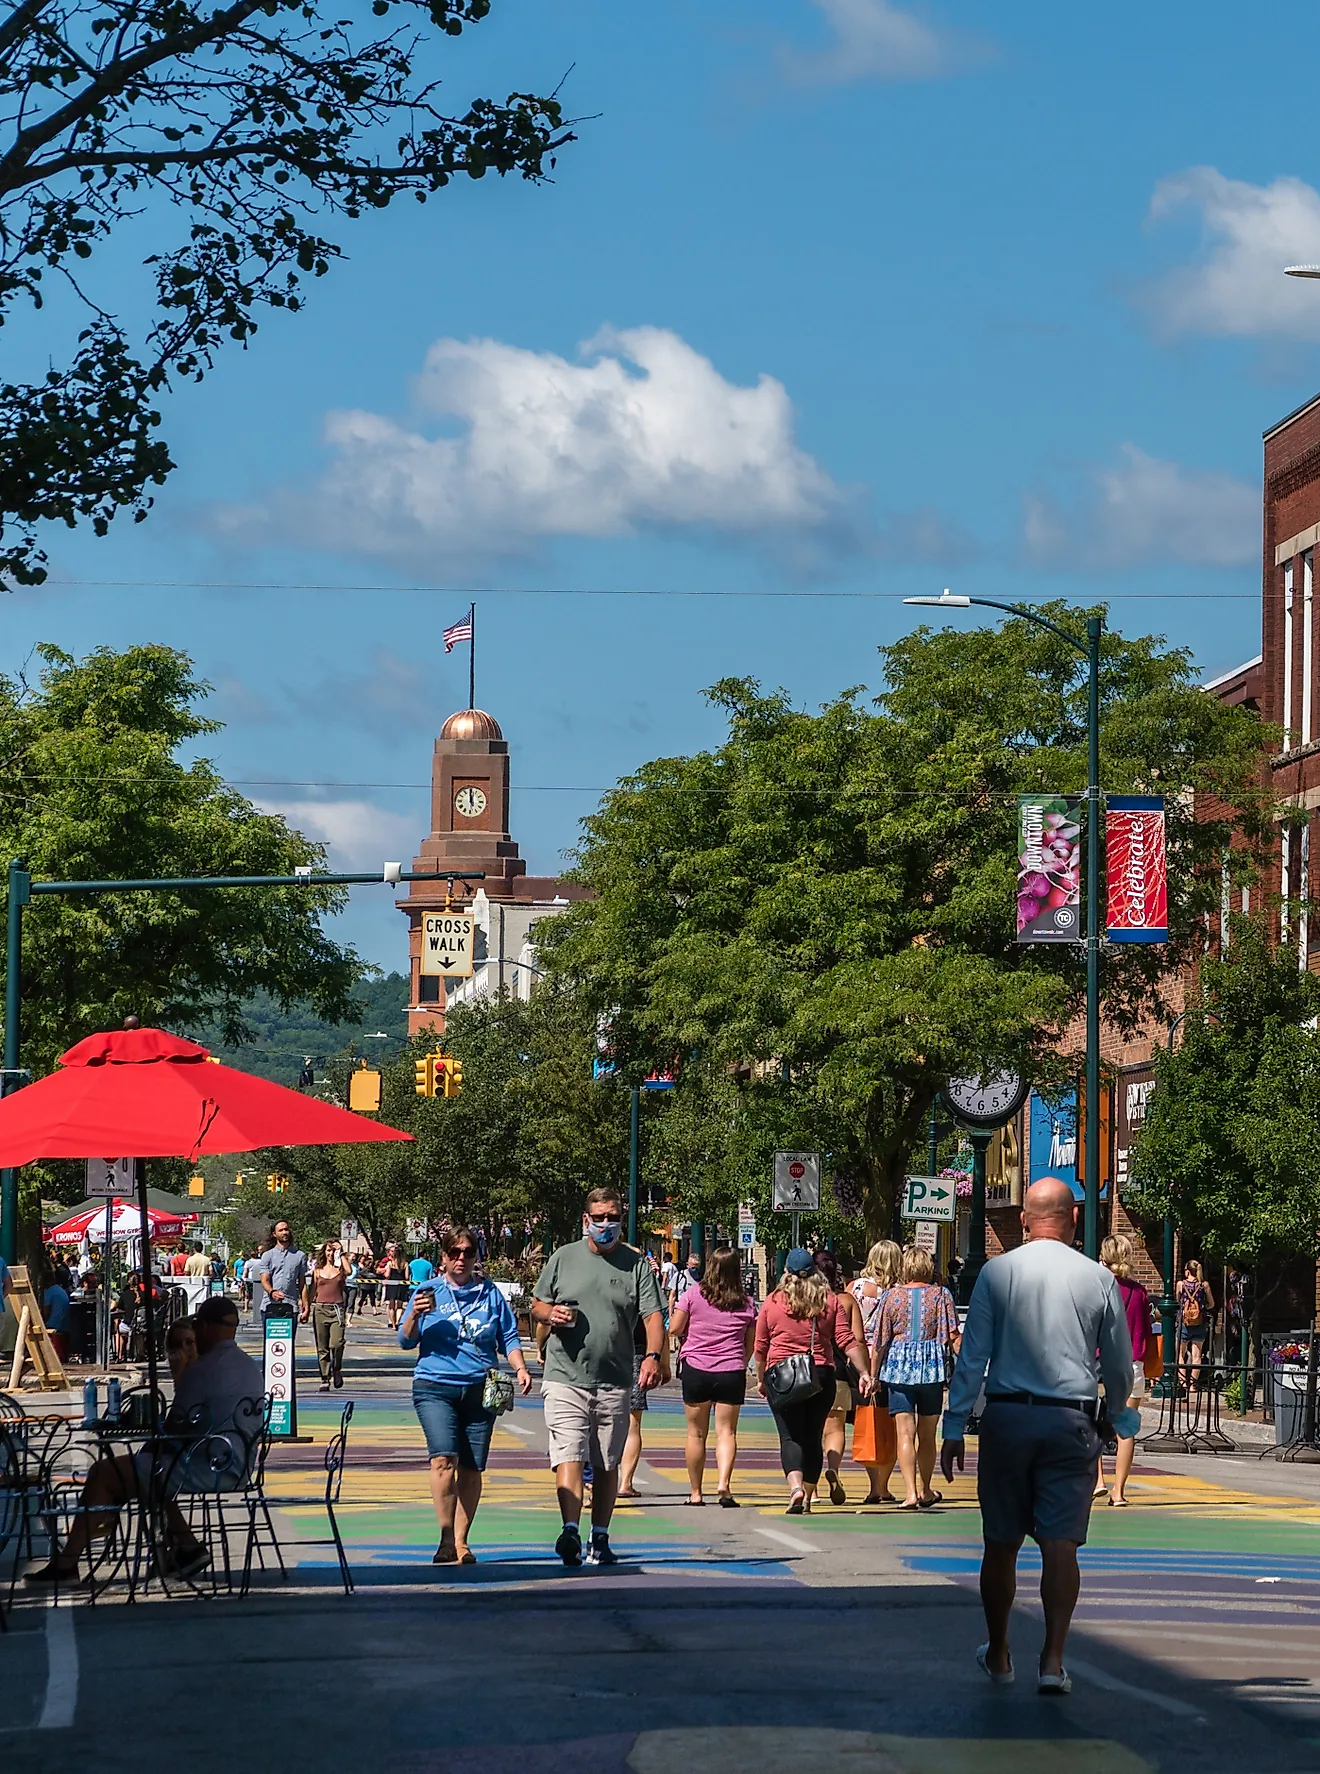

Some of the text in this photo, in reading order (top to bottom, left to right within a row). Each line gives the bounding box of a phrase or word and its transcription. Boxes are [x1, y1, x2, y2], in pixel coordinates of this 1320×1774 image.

[1027, 805, 1043, 870] DOWNTOWN
[1126, 813, 1147, 926] Celebrate!
[1059, 914, 1069, 922] TC
[426, 917, 471, 935] CROSS
[429, 936, 466, 953] WALK
[955, 1086, 962, 1096] 8
[1001, 1087, 1009, 1098] 4
[965, 1096, 972, 1107] 7
[977, 1100, 985, 1110] 6
[992, 1096, 999, 1107] 5
[55, 1231, 83, 1243] KRONOS
